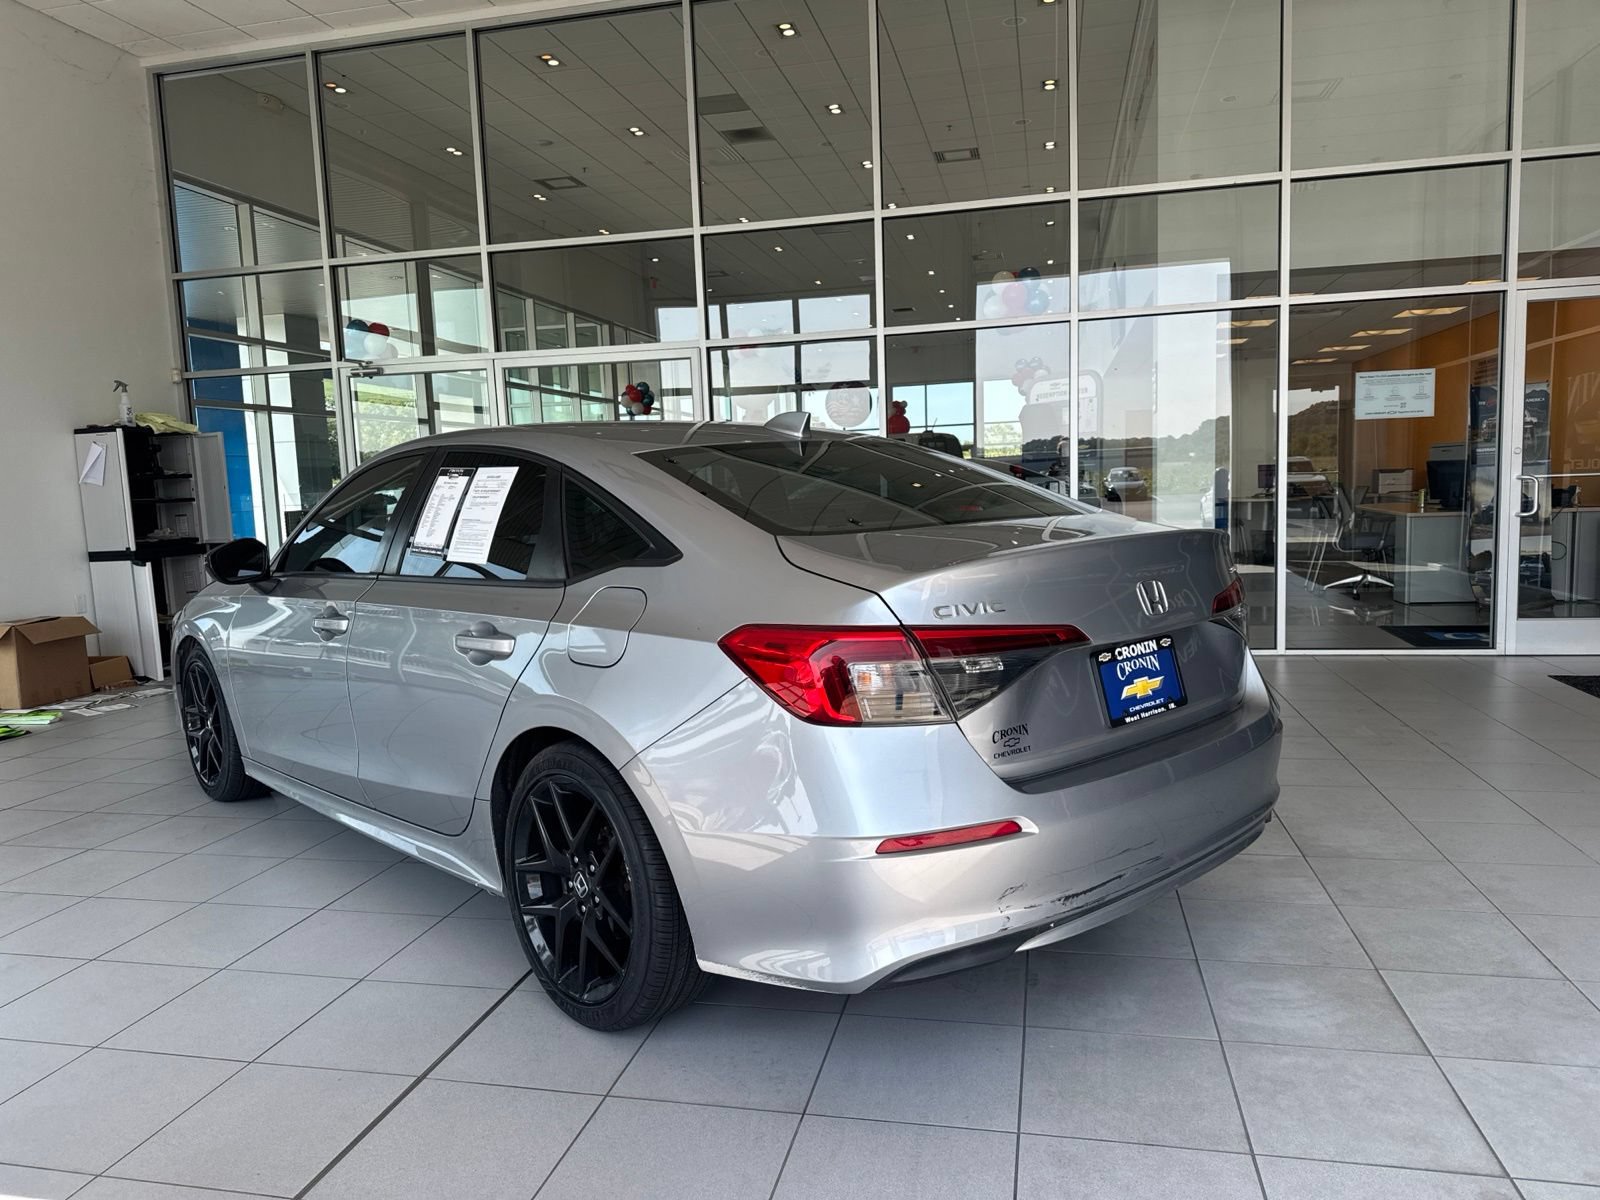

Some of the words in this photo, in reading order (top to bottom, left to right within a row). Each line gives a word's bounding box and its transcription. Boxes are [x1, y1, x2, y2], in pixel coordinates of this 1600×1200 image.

[933, 601, 1007, 620] CIVIC
[1115, 640, 1157, 660] CRONIN
[1117, 654, 1160, 681] CRONIN
[1129, 697, 1164, 712] CHEVROLET
[1124, 714, 1140, 724] West
[992, 723, 1029, 744] CRONIN
[993, 745, 1031, 760] CHEVROLET
